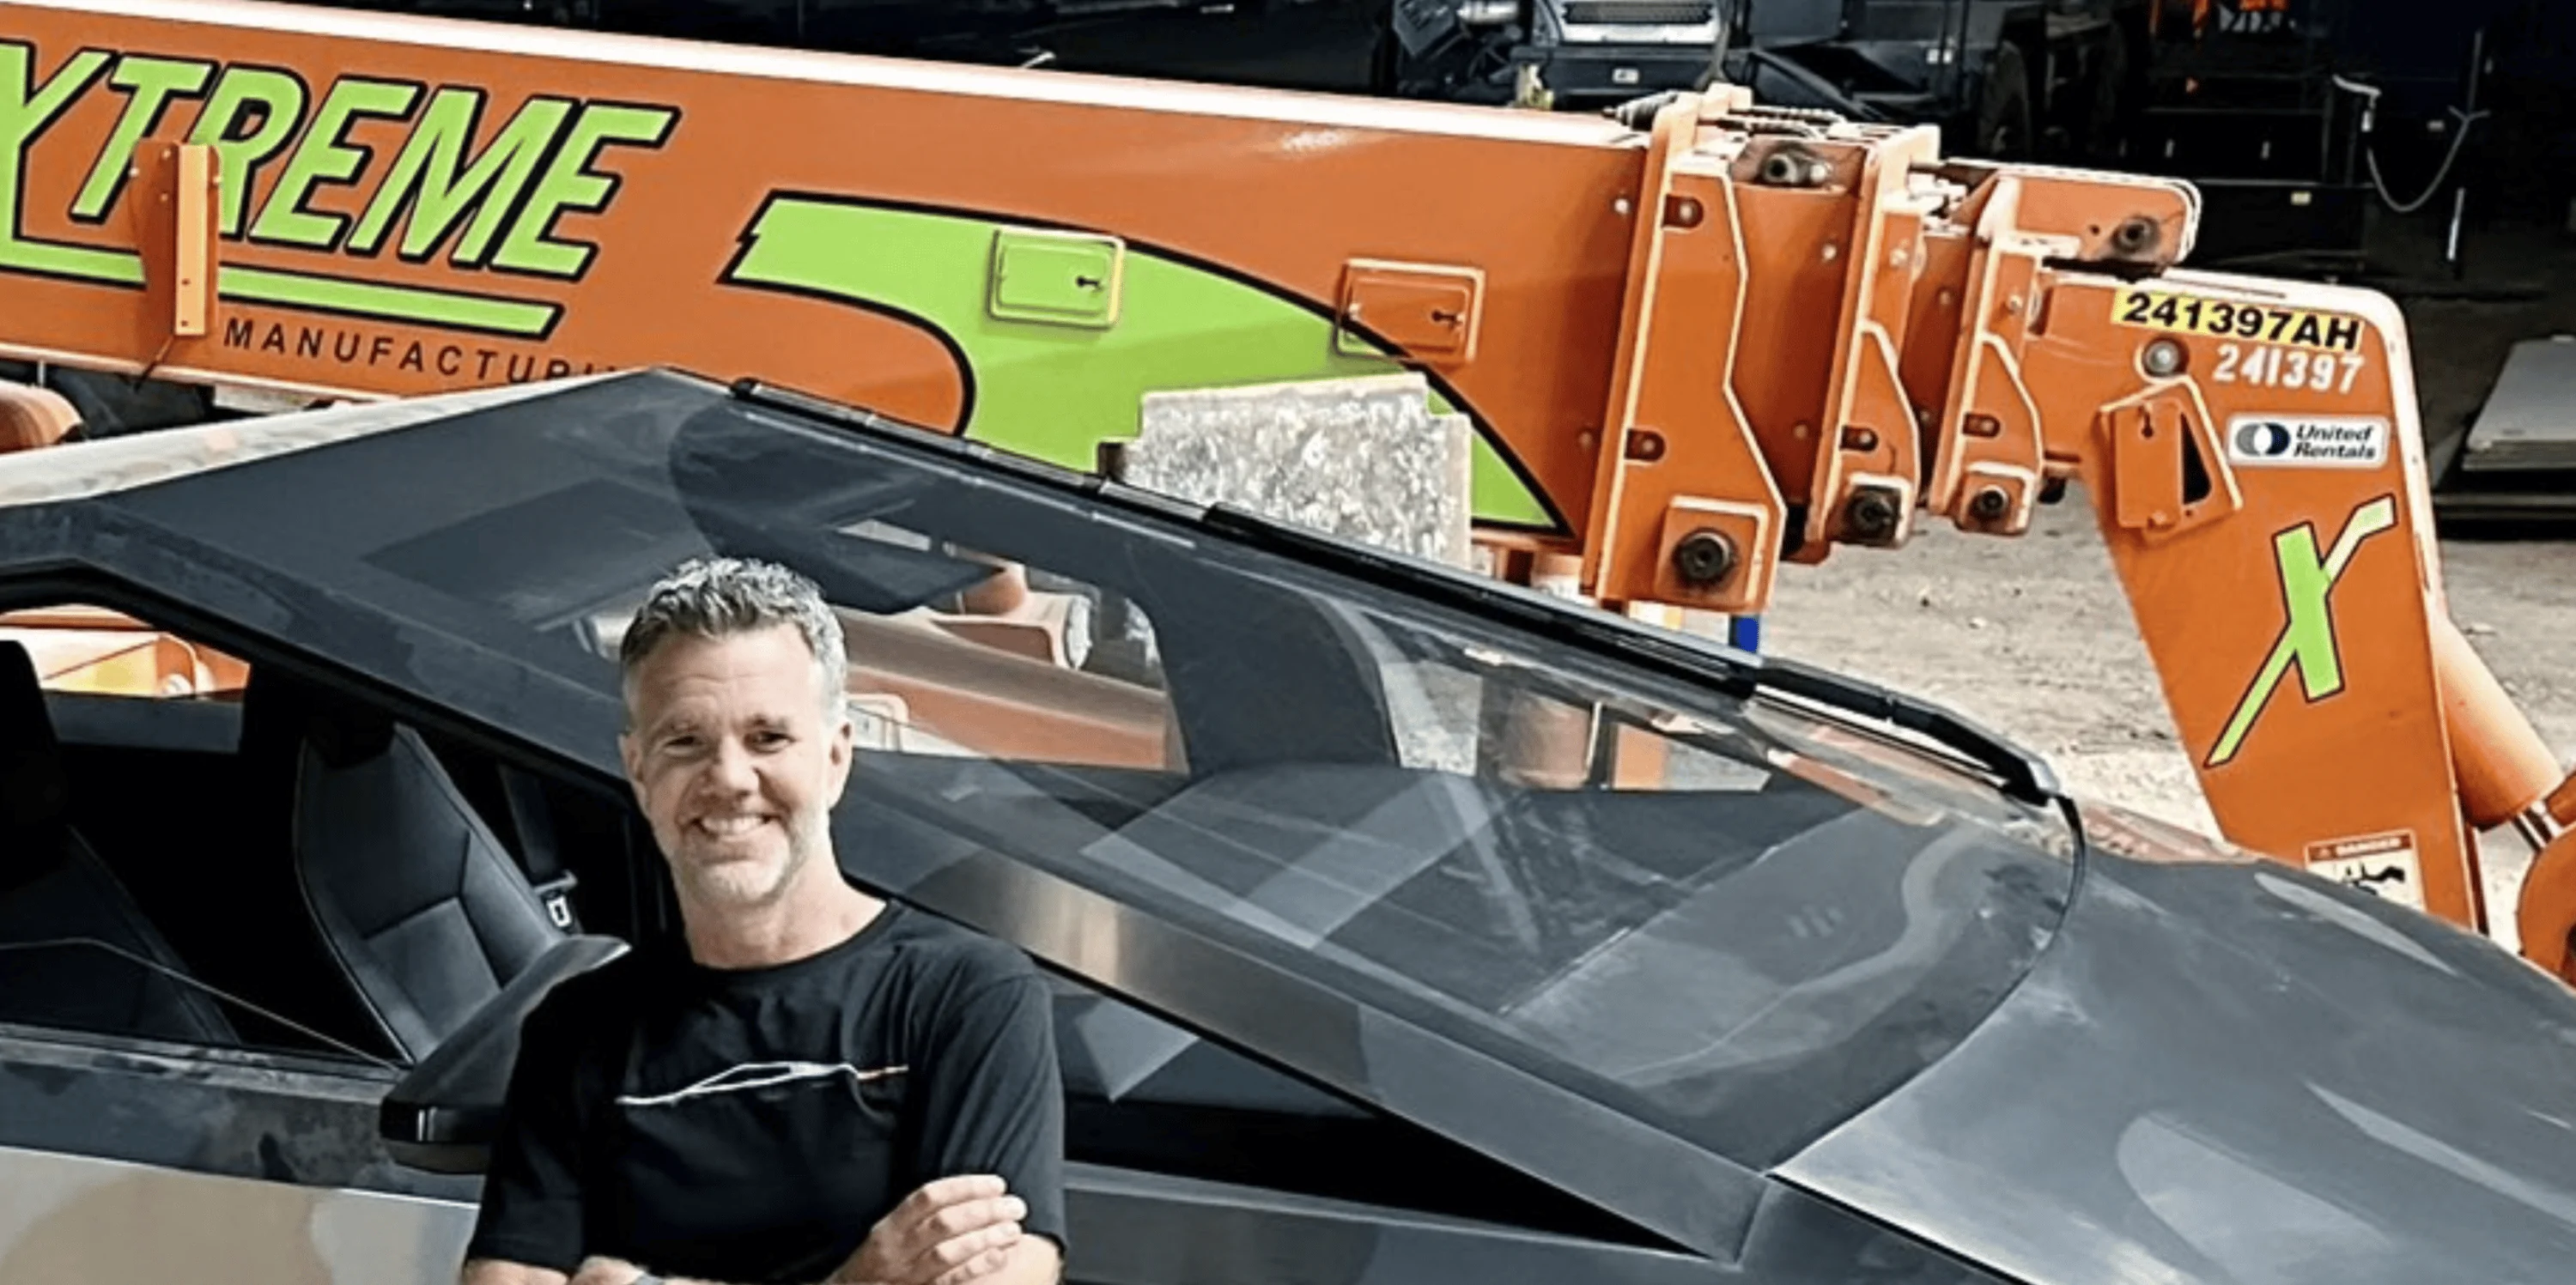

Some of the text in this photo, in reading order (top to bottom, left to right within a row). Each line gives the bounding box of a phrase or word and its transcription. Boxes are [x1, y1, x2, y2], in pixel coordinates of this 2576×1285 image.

[2123, 292, 2359, 350] 241397AH
[2212, 344, 2365, 395] 241397
[2293, 441, 2376, 459] Rentals
[2296, 424, 2373, 442] United
